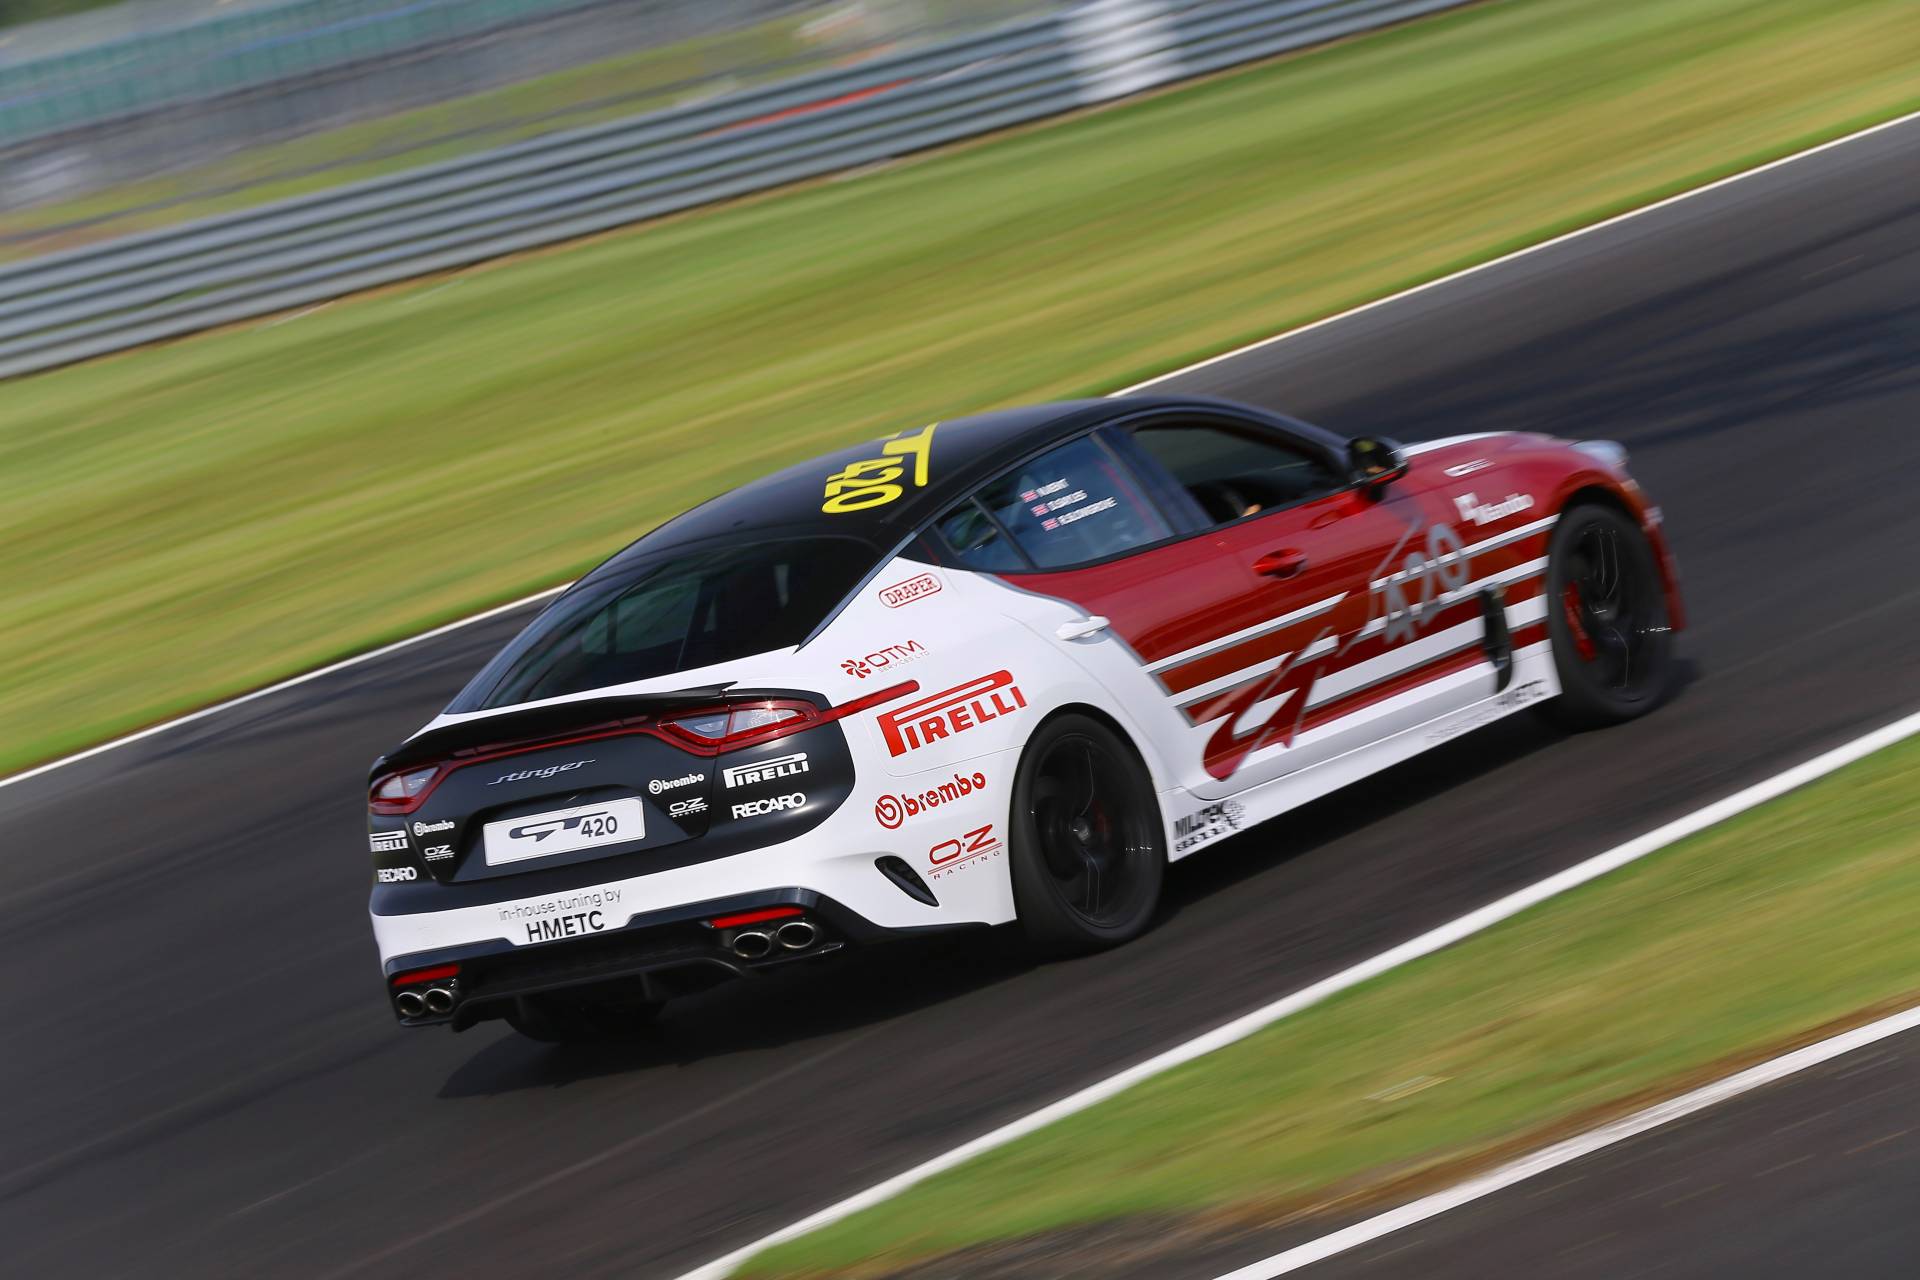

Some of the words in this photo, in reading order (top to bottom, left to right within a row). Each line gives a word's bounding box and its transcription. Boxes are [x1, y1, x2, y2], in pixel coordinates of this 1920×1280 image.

[821, 455, 904, 514] 420
[884, 577, 938, 605] DRAPER
[864, 639, 926, 668] OTM
[876, 669, 1028, 758] PIRELLI
[661, 772, 705, 791] brembo
[722, 752, 810, 789] PIRELLI
[731, 792, 807, 820] RECARO
[902, 772, 986, 817] brembo
[580, 815, 618, 838] 420
[377, 866, 418, 883] RECARO
[933, 850, 1001, 881] RACING
[558, 891, 602, 910] tuning
[604, 888, 622, 903] by
[525, 910, 605, 942] HMETC
